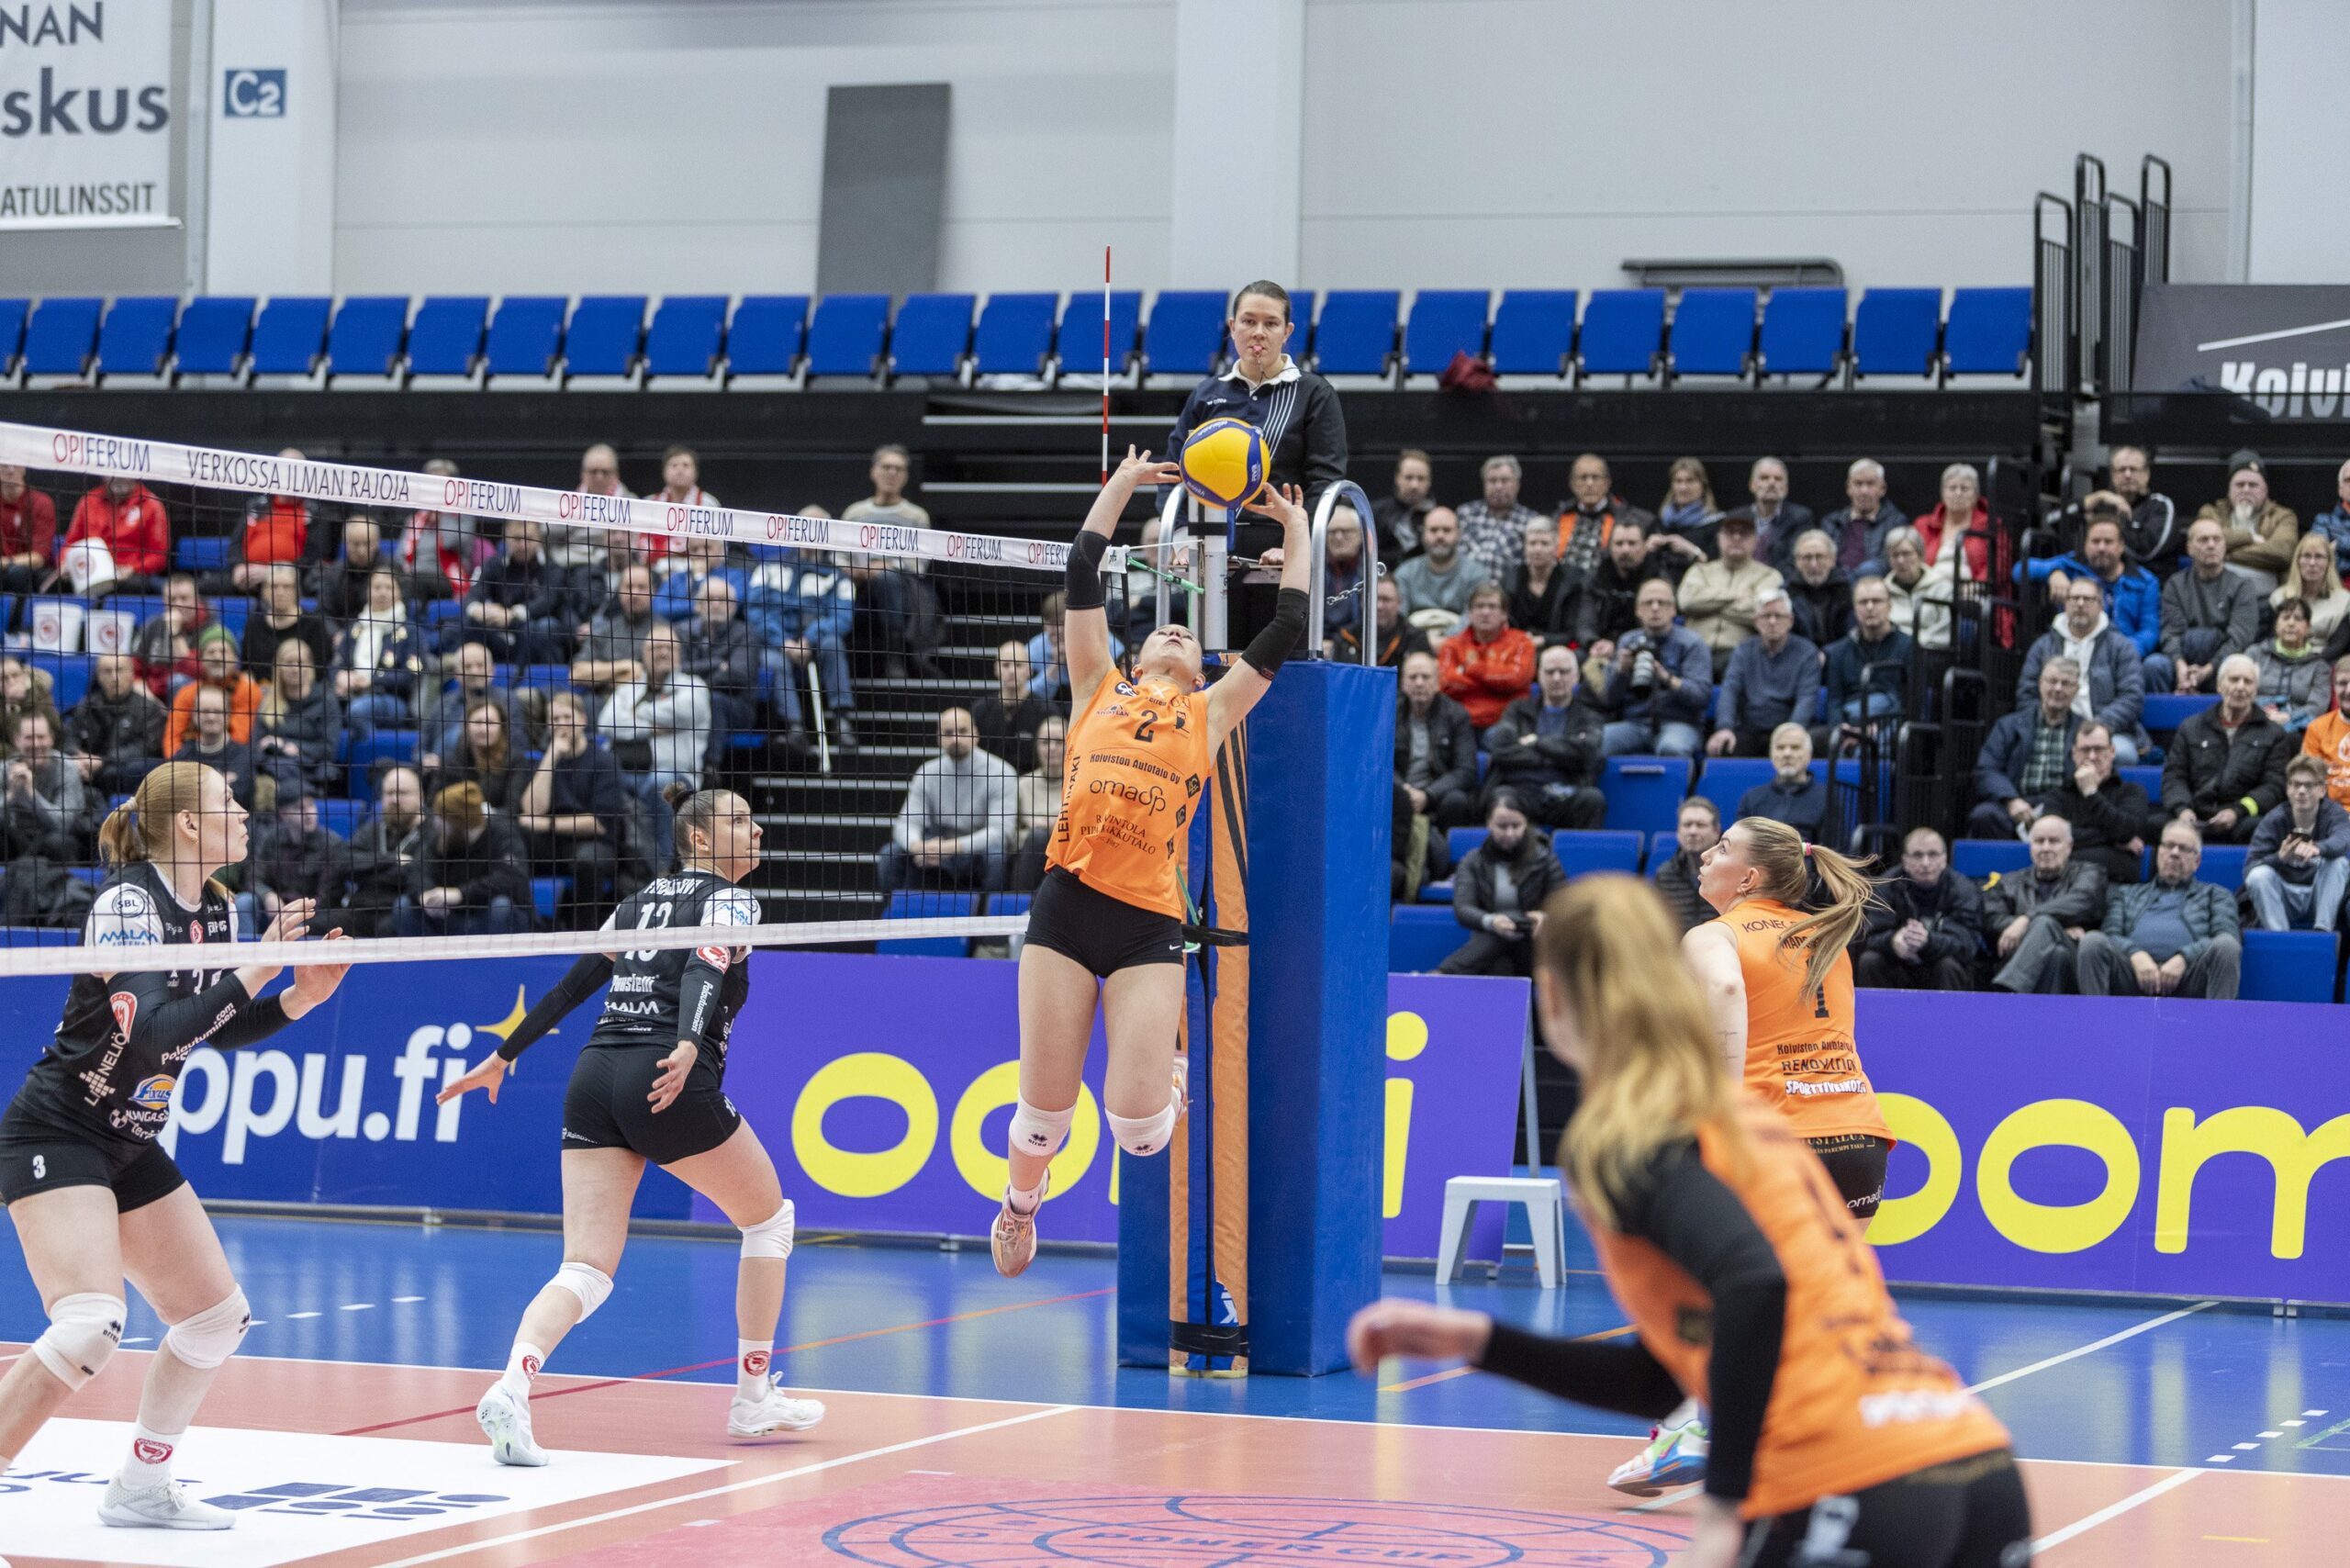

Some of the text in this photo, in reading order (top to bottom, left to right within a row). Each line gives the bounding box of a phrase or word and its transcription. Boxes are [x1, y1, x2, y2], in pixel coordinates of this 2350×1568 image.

[1, 67, 169, 137] skus
[229, 72, 281, 117] C2
[0, 184, 156, 217] ATULINSSIT
[53, 433, 1071, 566] OPIFERUM VERKOSSA ILMAN RAJOJA OPIFERUM OPIFERUM OPIFERUM OPIFERUM OPIFERUM OPIFERUM OPIFERU
[1135, 710, 1158, 743] 2
[1090, 753, 1131, 767] Koiviston
[1132, 759, 1169, 779] Autotalo
[1169, 772, 1181, 785] Oy
[1096, 814, 1146, 838] RVINTOLA
[161, 1002, 238, 1066] Palautuminen .com
[1776, 1041, 1819, 1055] Koiviston
[32, 1154, 47, 1180] 3
[1082, 1532, 1476, 1562] POWER CUP
